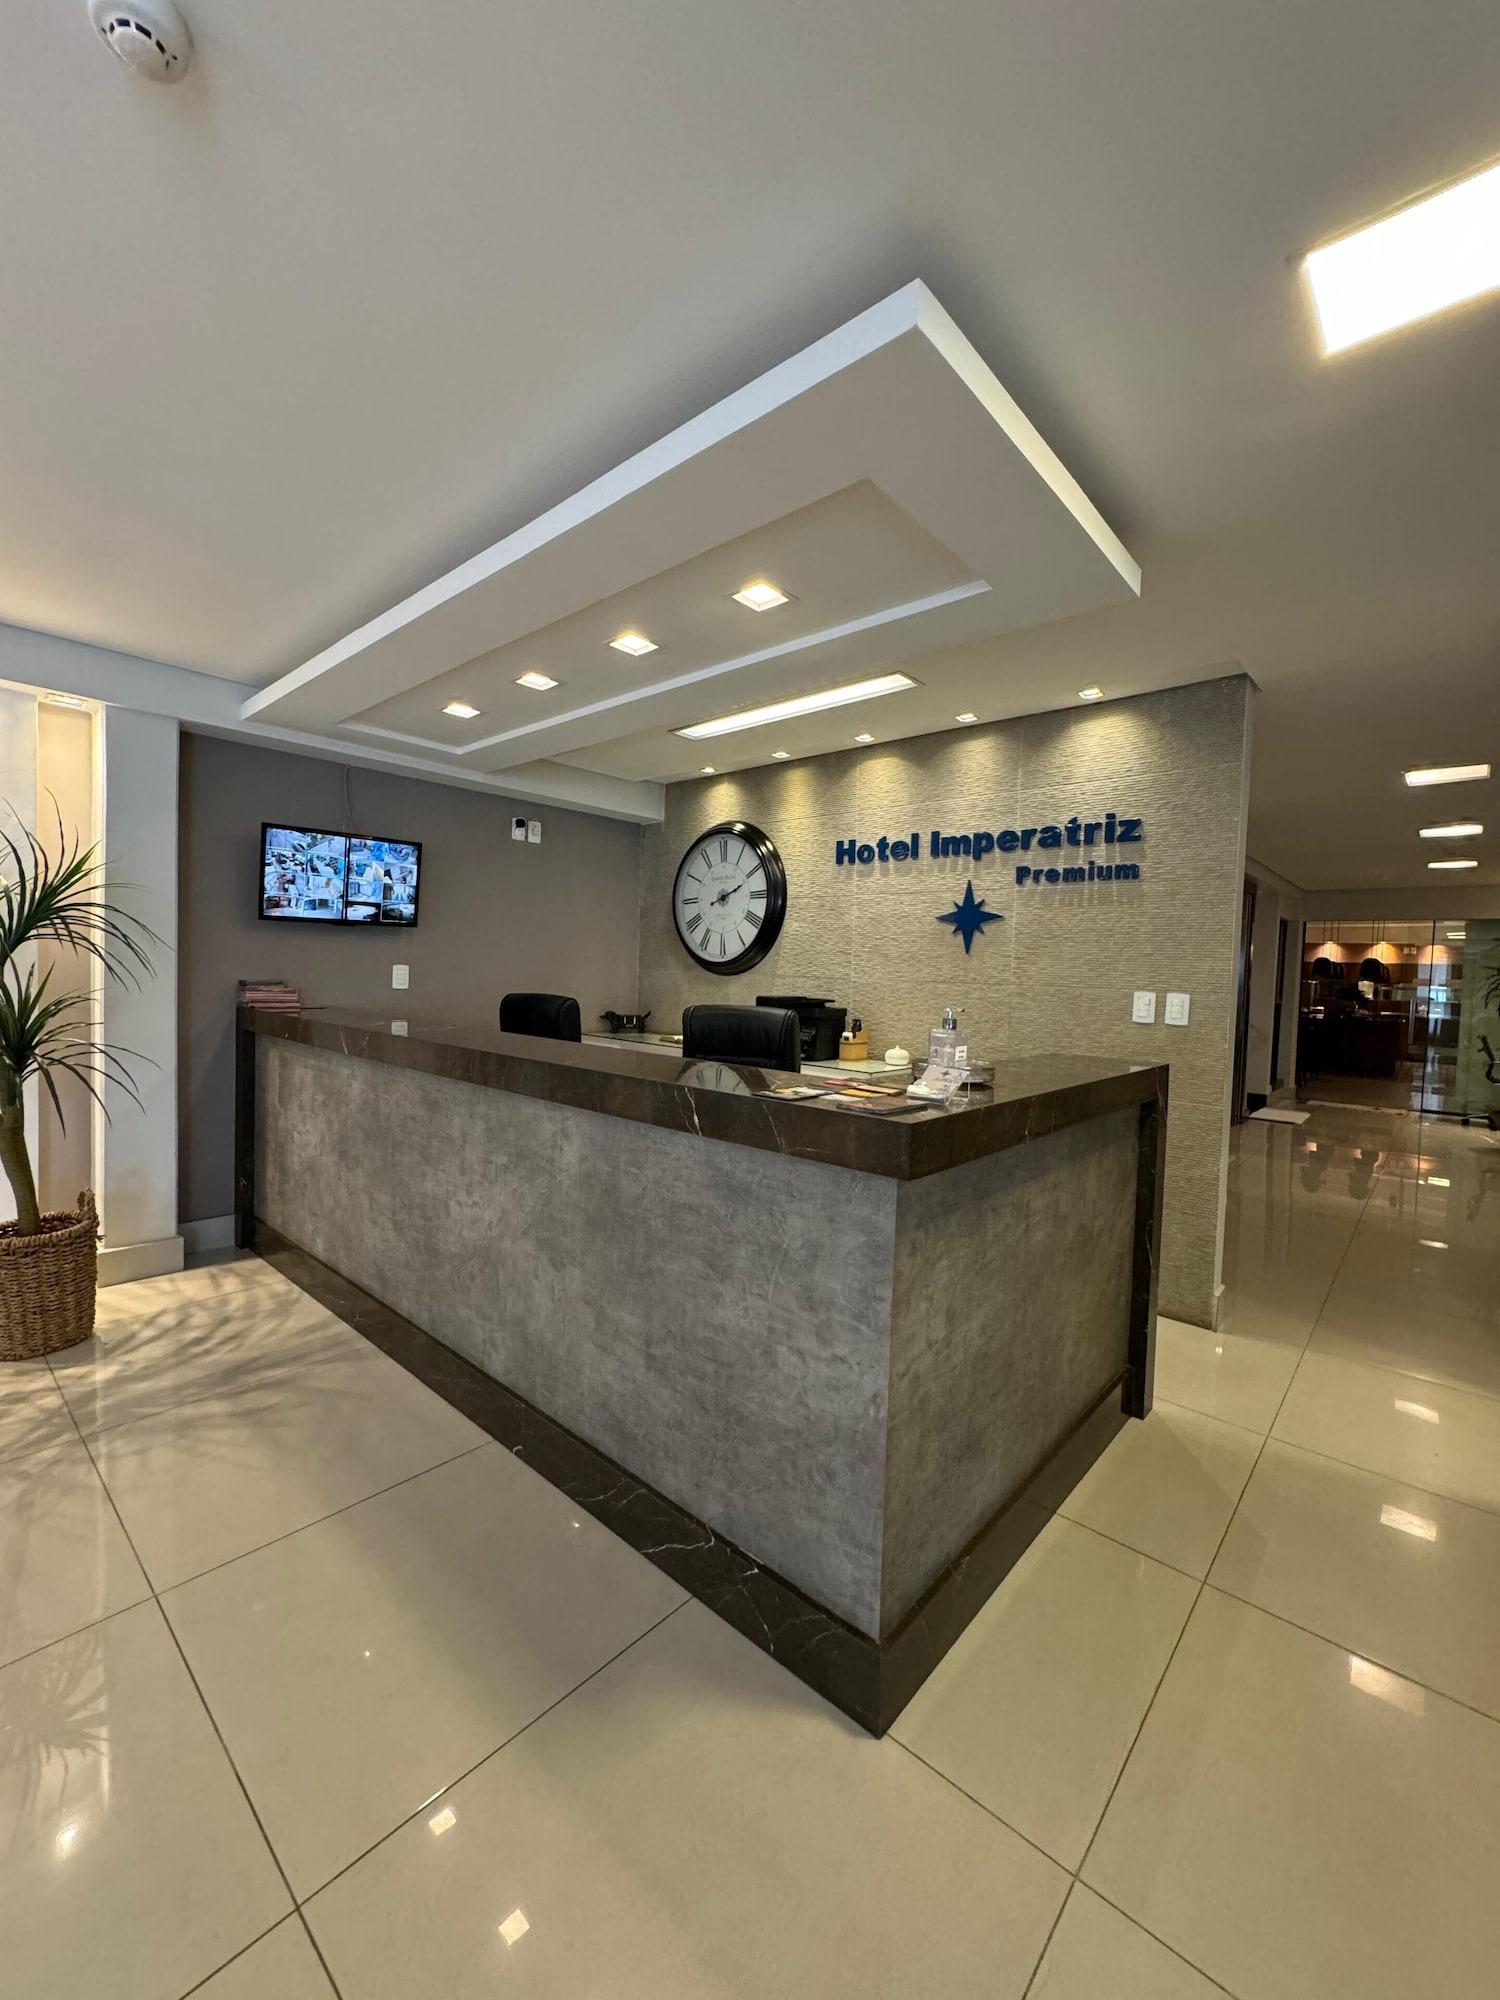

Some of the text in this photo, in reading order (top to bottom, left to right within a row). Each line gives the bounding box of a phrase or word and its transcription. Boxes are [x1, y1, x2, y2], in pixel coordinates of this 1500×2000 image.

[836, 813, 1142, 865] Hotel Imperatriz
[1015, 860, 1140, 885] Premium
